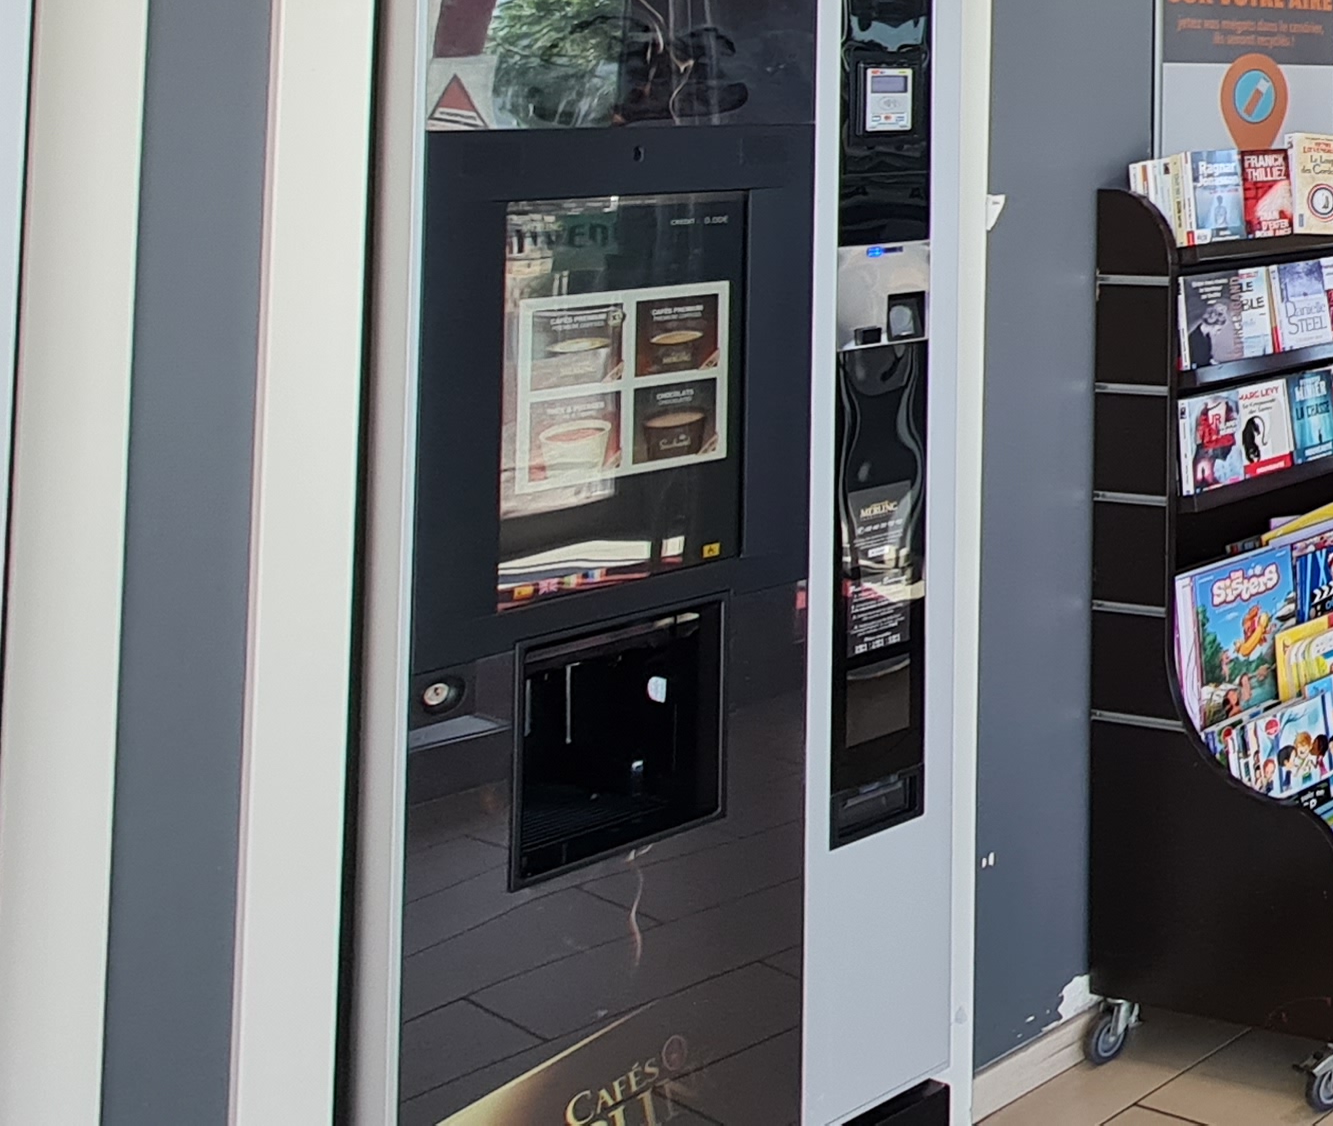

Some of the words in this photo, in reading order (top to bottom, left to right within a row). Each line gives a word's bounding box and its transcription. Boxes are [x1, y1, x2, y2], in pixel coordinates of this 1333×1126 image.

[1243, 154, 1285, 168] FRANCK
[1246, 166, 1287, 182] THILLIEZ
[1288, 315, 1328, 335] STEEL
[1260, 385, 1280, 398] LEVY
[565, 1057, 660, 1124] CAFÉS
